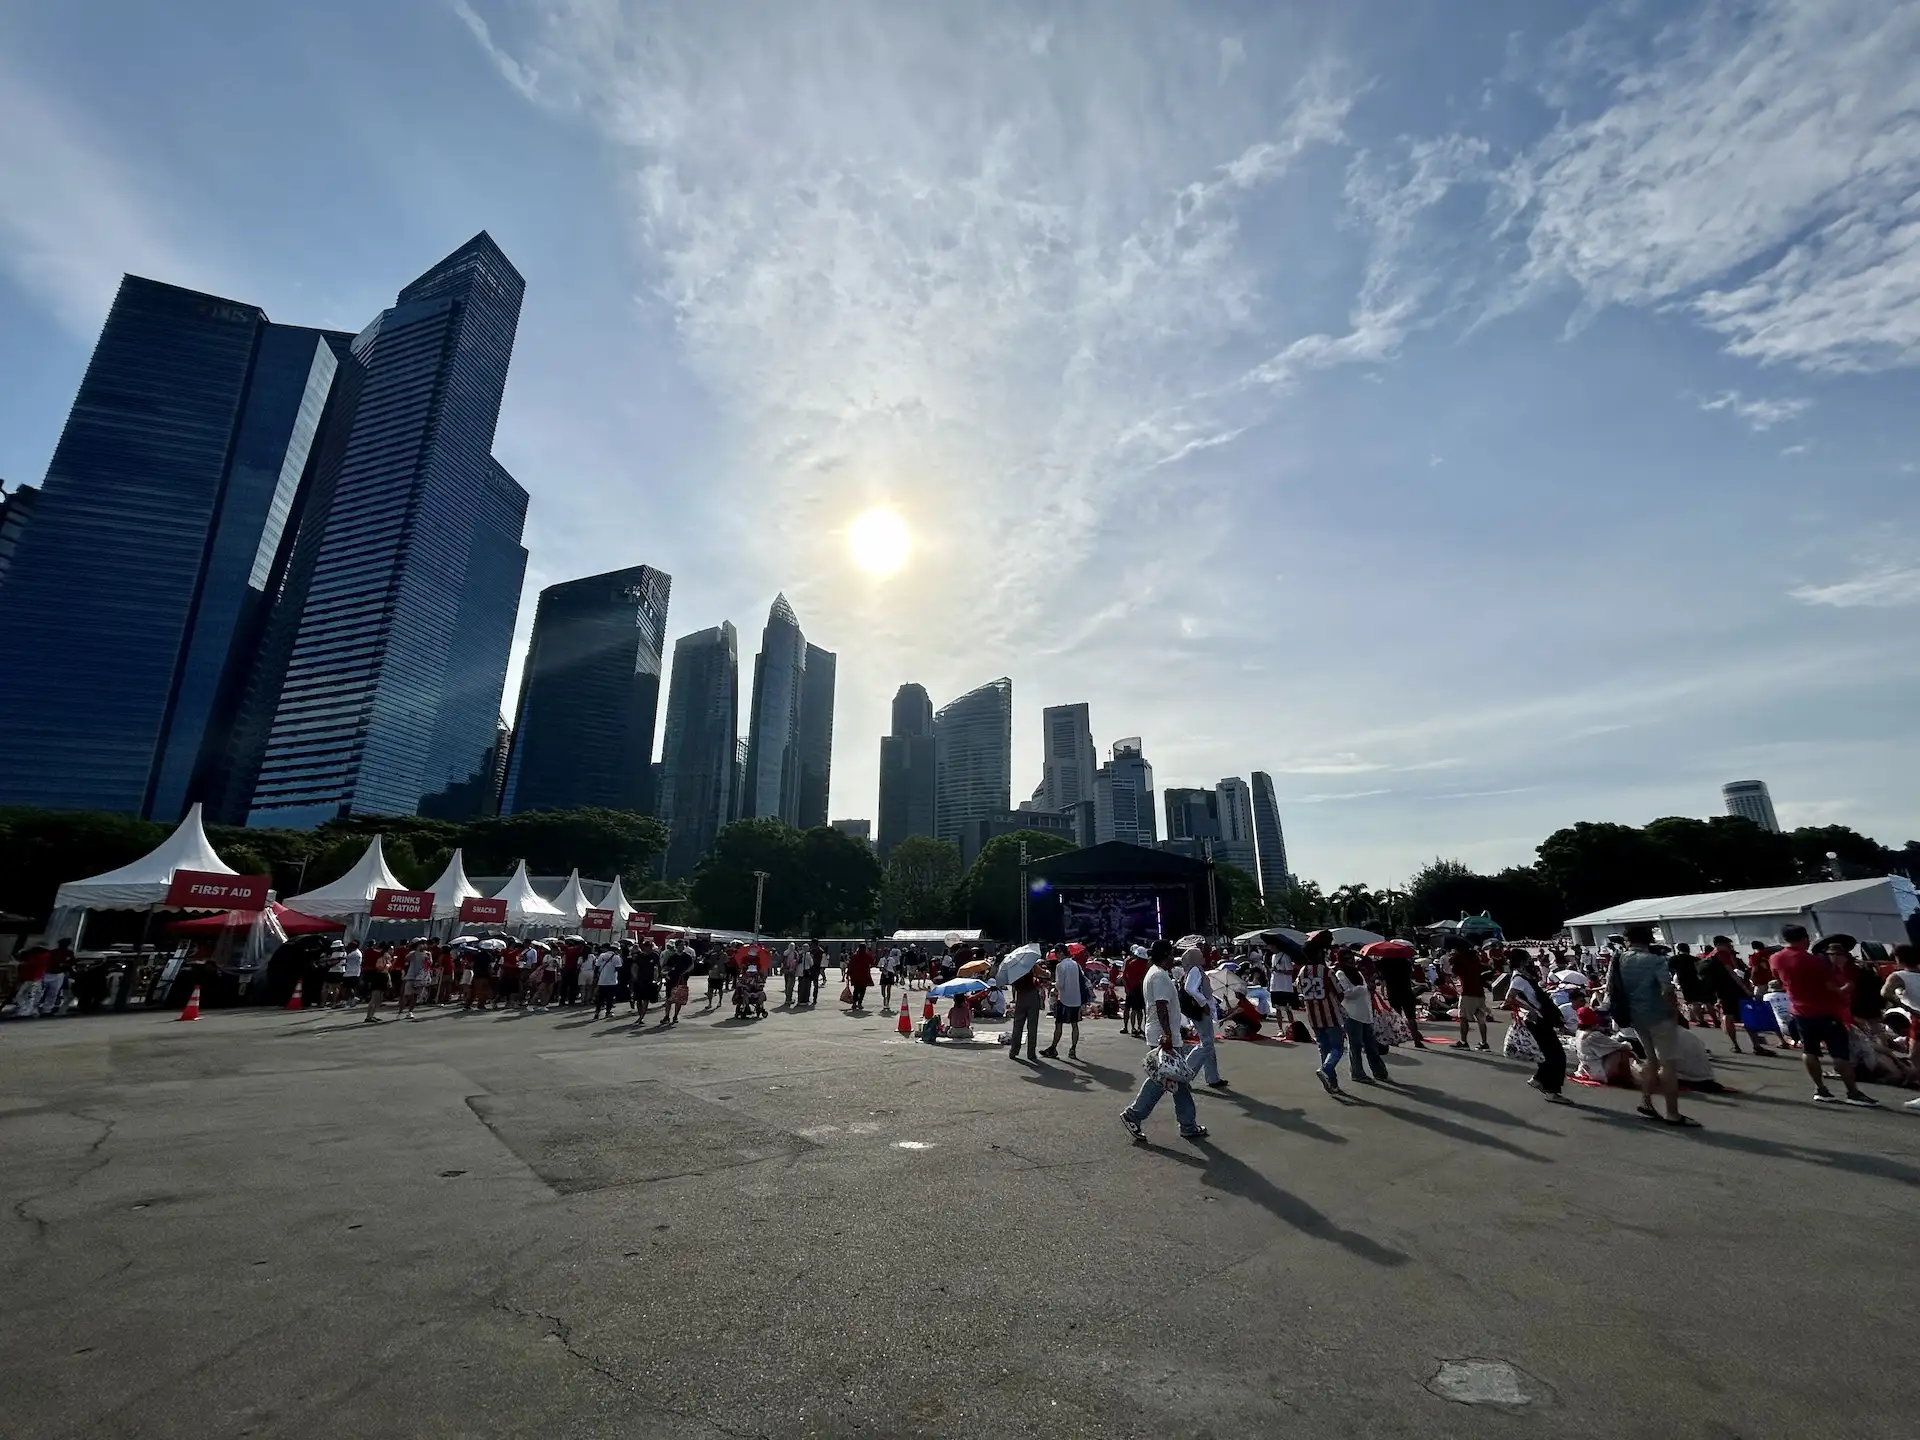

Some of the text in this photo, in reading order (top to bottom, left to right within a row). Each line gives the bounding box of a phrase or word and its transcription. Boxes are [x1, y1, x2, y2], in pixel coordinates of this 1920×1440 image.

[190, 884, 252, 898] FIRST AID
[391, 894, 421, 904] DRINKS
[387, 903, 421, 913] STATION
[472, 906, 497, 914] SNACKS
[1301, 977, 1325, 1000] 23
